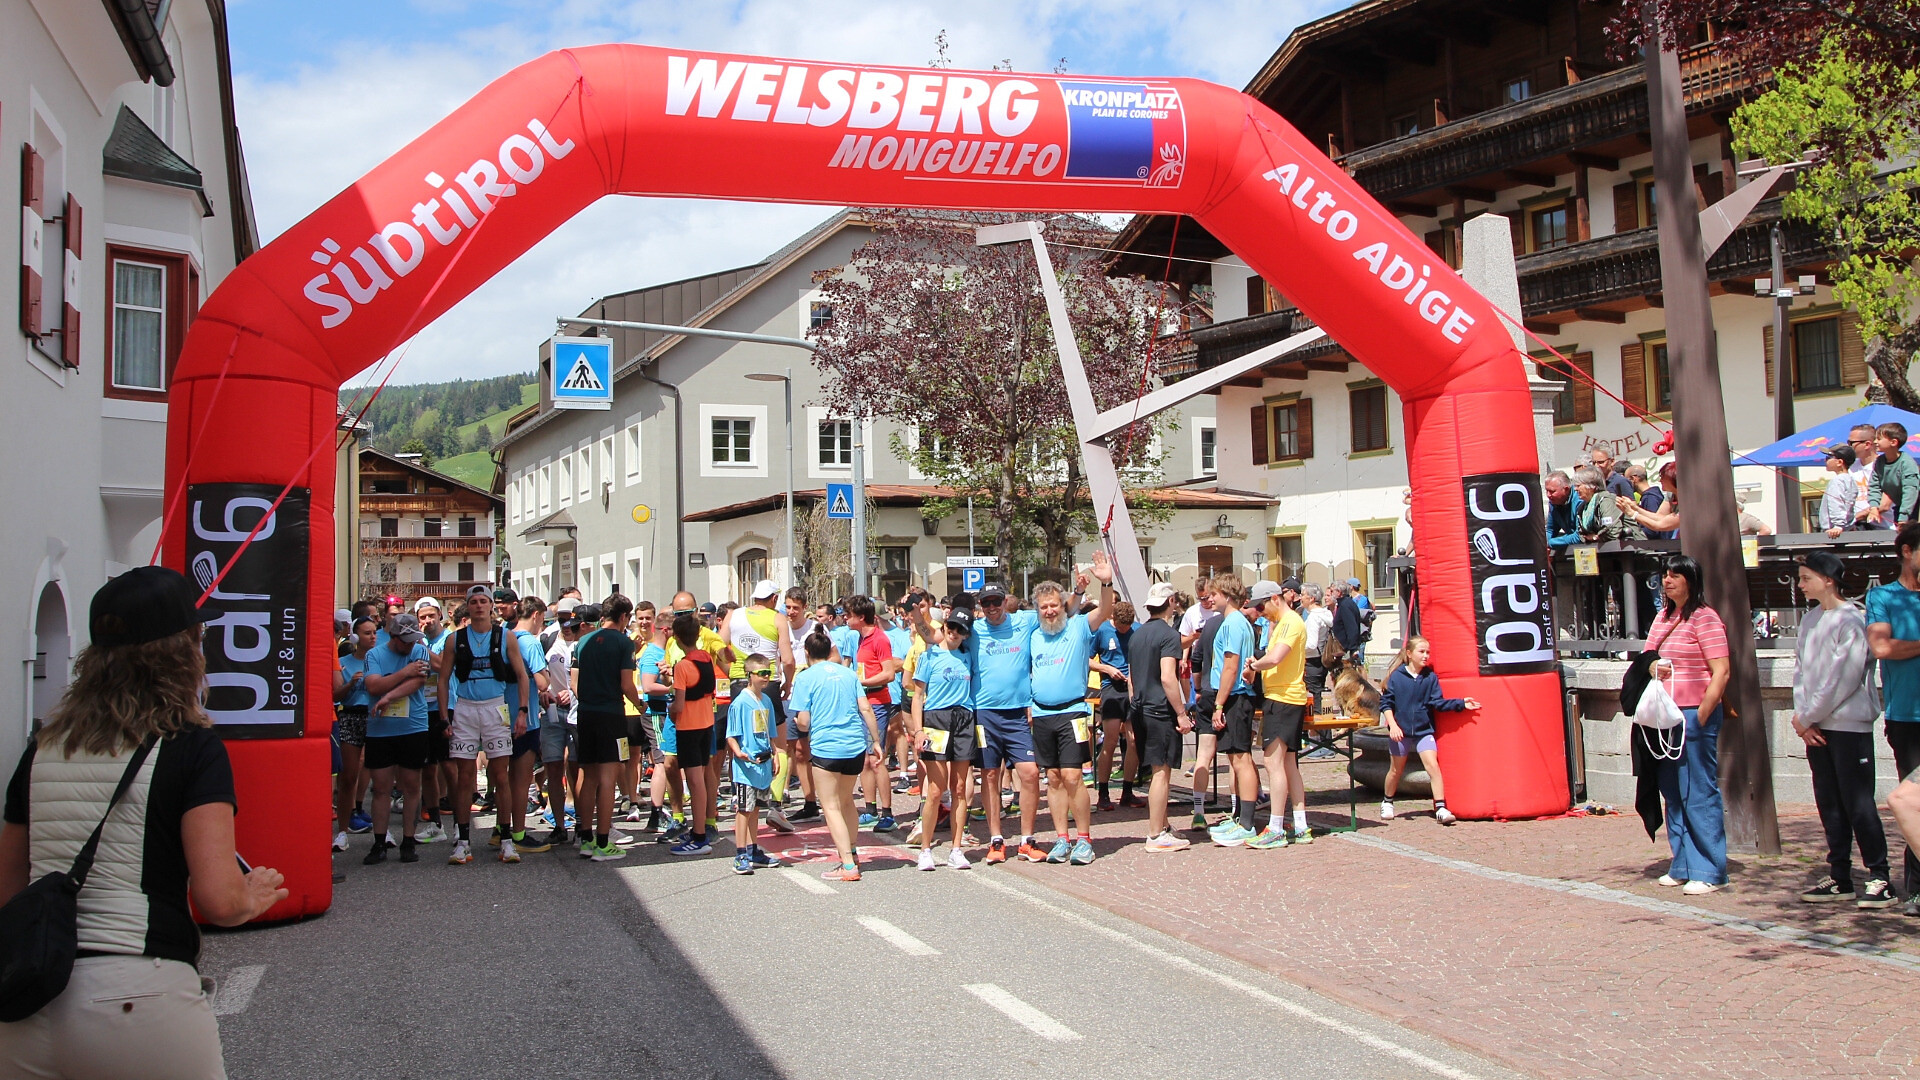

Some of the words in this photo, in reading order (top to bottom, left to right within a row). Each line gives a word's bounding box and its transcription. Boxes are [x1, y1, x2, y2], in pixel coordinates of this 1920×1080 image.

[665, 56, 1039, 137] WELSBERG
[1065, 89, 1178, 110] KRONPLATZ
[1092, 108, 1115, 118] PLAN
[1116, 109, 1128, 118] DE
[1129, 109, 1168, 119] CORONES
[828, 135, 1062, 178] MONGUELFO
[967, 570, 981, 589] P
[1540, 568, 1549, 596] run
[1541, 601, 1550, 611] &
[282, 607, 296, 641] run
[1543, 614, 1554, 646] golf
[279, 647, 295, 661] &
[278, 665, 297, 706] golf
